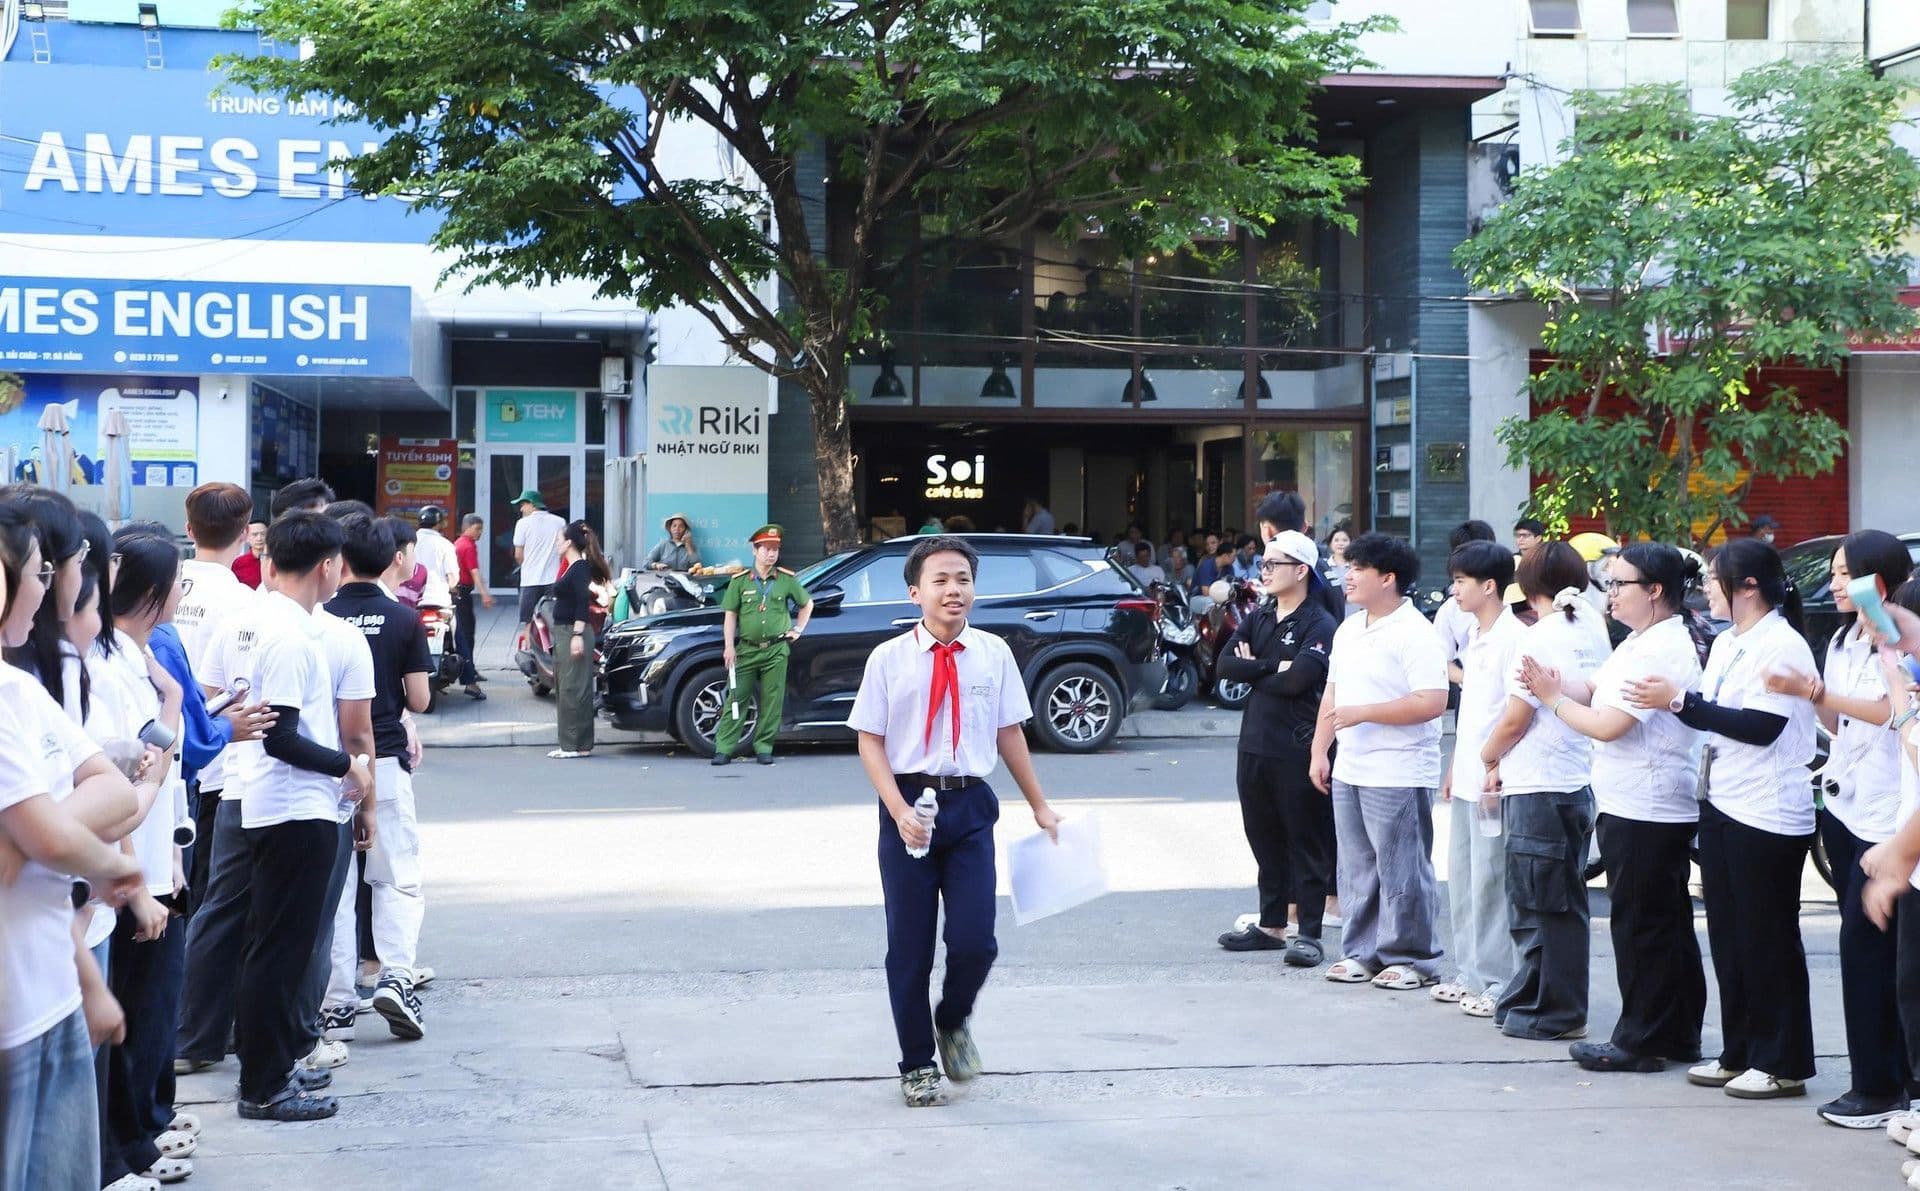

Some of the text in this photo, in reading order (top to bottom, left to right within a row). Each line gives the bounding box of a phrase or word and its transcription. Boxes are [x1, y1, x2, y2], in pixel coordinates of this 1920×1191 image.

[208, 95, 280, 115] TRUNG
[25, 131, 259, 198] AMES
[113, 290, 368, 341] ENGLISH
[699, 406, 760, 435] Riki
[425, 453, 452, 463] SINH
[657, 440, 760, 457] NHẬT NGỮ RIKI
[927, 454, 985, 485] Soi
